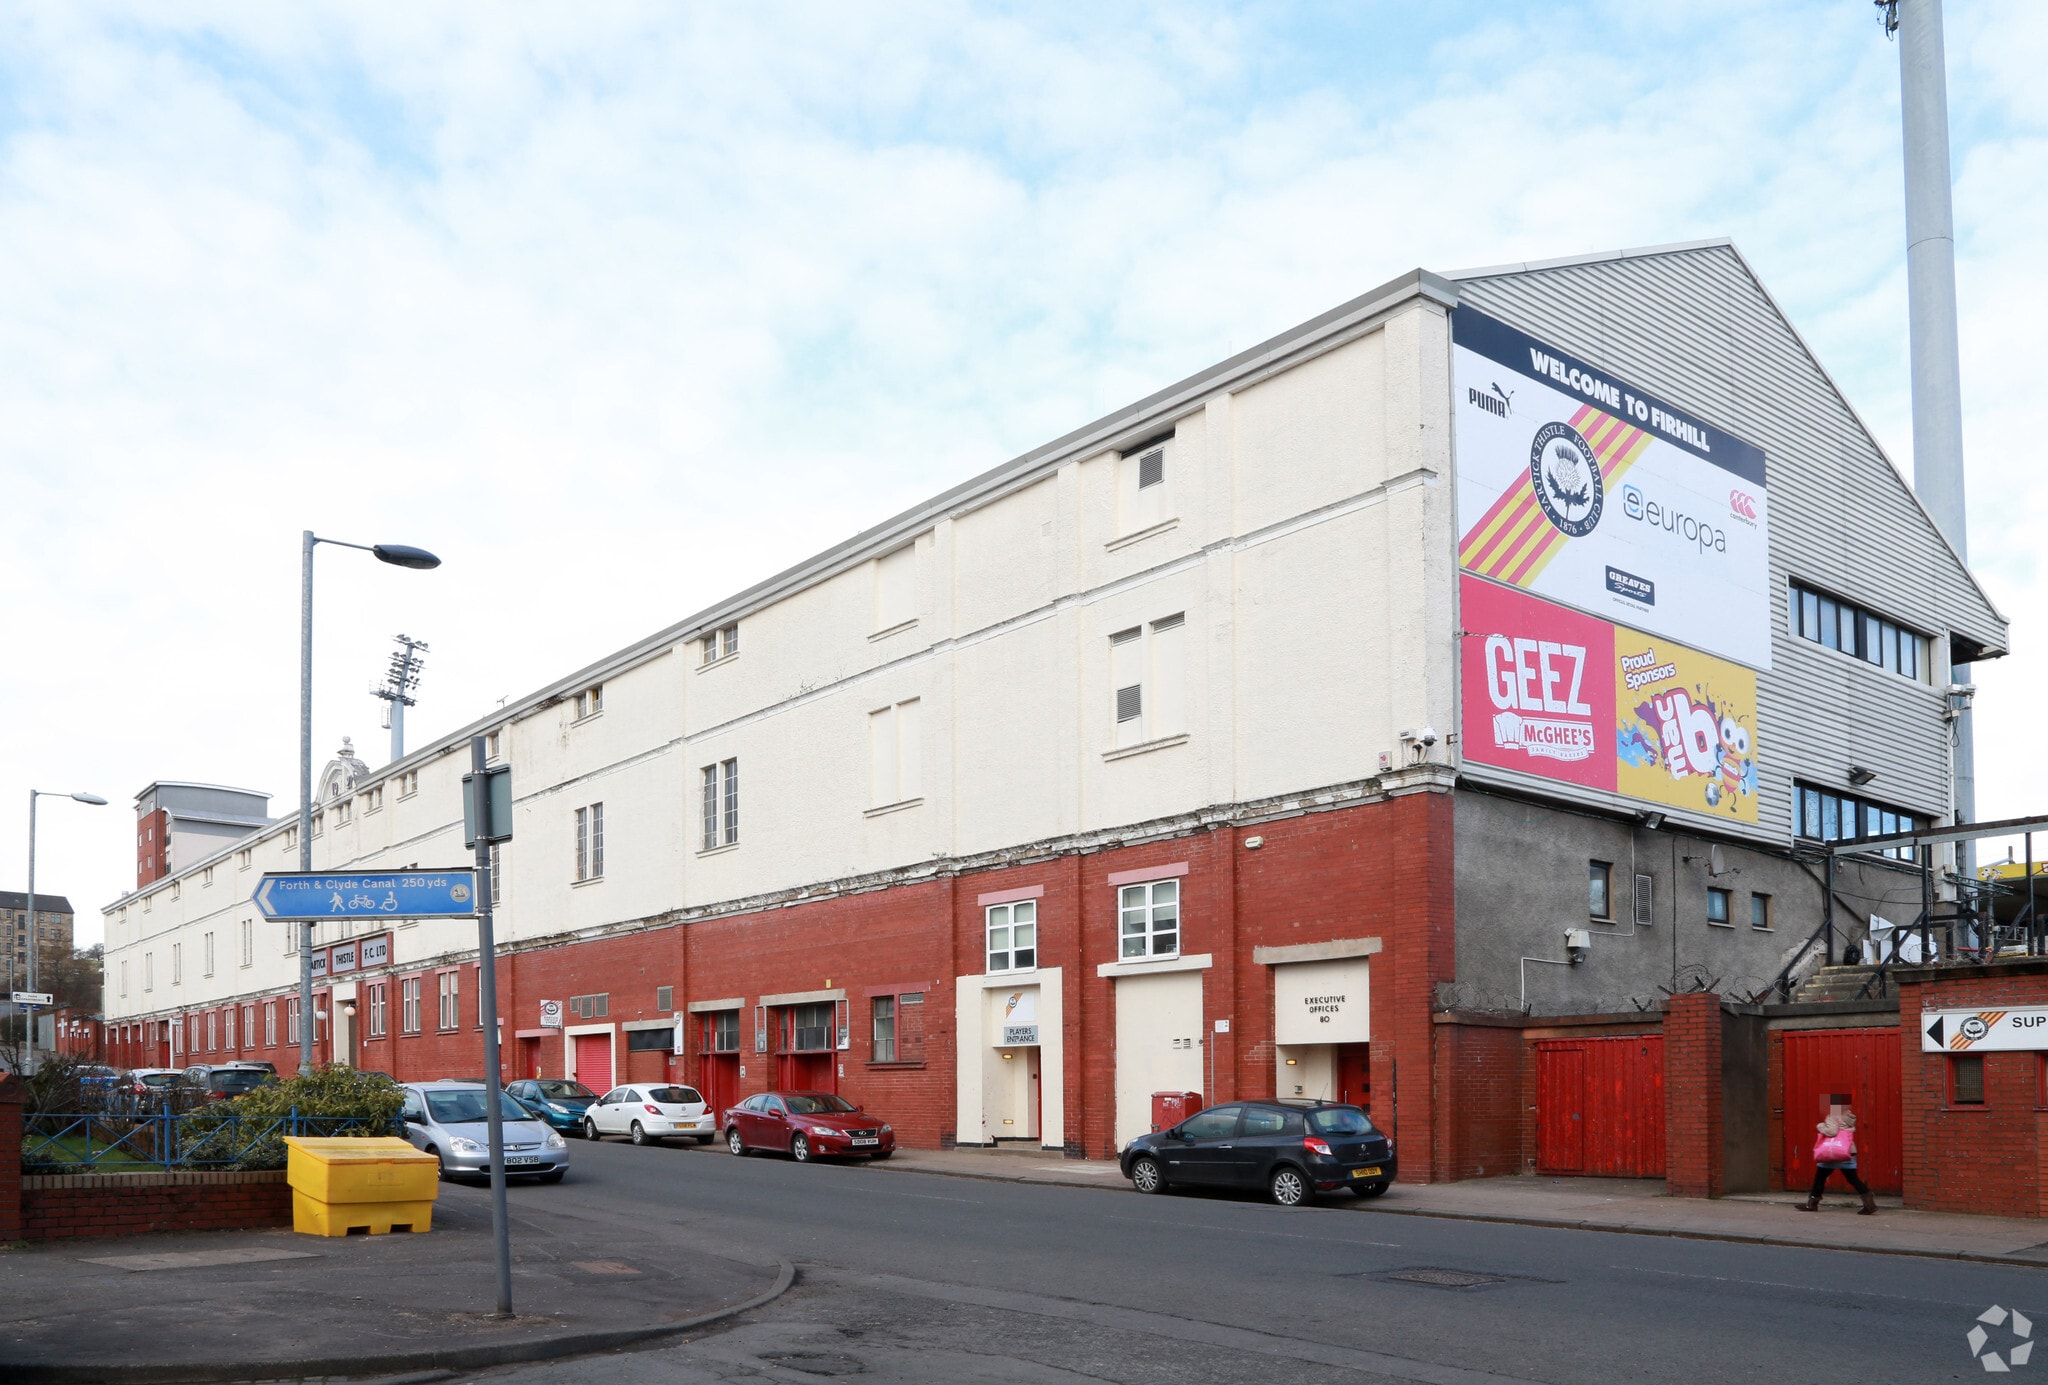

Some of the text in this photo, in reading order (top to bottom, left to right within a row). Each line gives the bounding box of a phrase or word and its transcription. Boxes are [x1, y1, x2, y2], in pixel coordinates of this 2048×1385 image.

[1469, 387, 1505, 419] PUMA
[1530, 348, 1710, 452] WELCOME TO FIRHILL
[1532, 424, 1602, 531] PARTICK THISTLE FOOTBALL CLUB
[1559, 519, 1578, 534] 1876
[1646, 501, 1726, 555] europa
[1609, 571, 1651, 593] GREAVES
[1621, 648, 1656, 672] Proud
[1485, 633, 1592, 716] GEEZ
[1625, 663, 1676, 691] Sponsors
[1524, 724, 1592, 746] McGHEE'S
[279, 877, 447, 891] Forth & Clyde Canal 250 yds
[311, 944, 387, 971] ARTICK THISTLE F.C. LTD
[1304, 995, 1346, 1005] EXECUTIVE
[1309, 1005, 1339, 1013] OFFICES
[1319, 1015, 1330, 1023] 80
[2012, 1016, 2046, 1028] SUP
